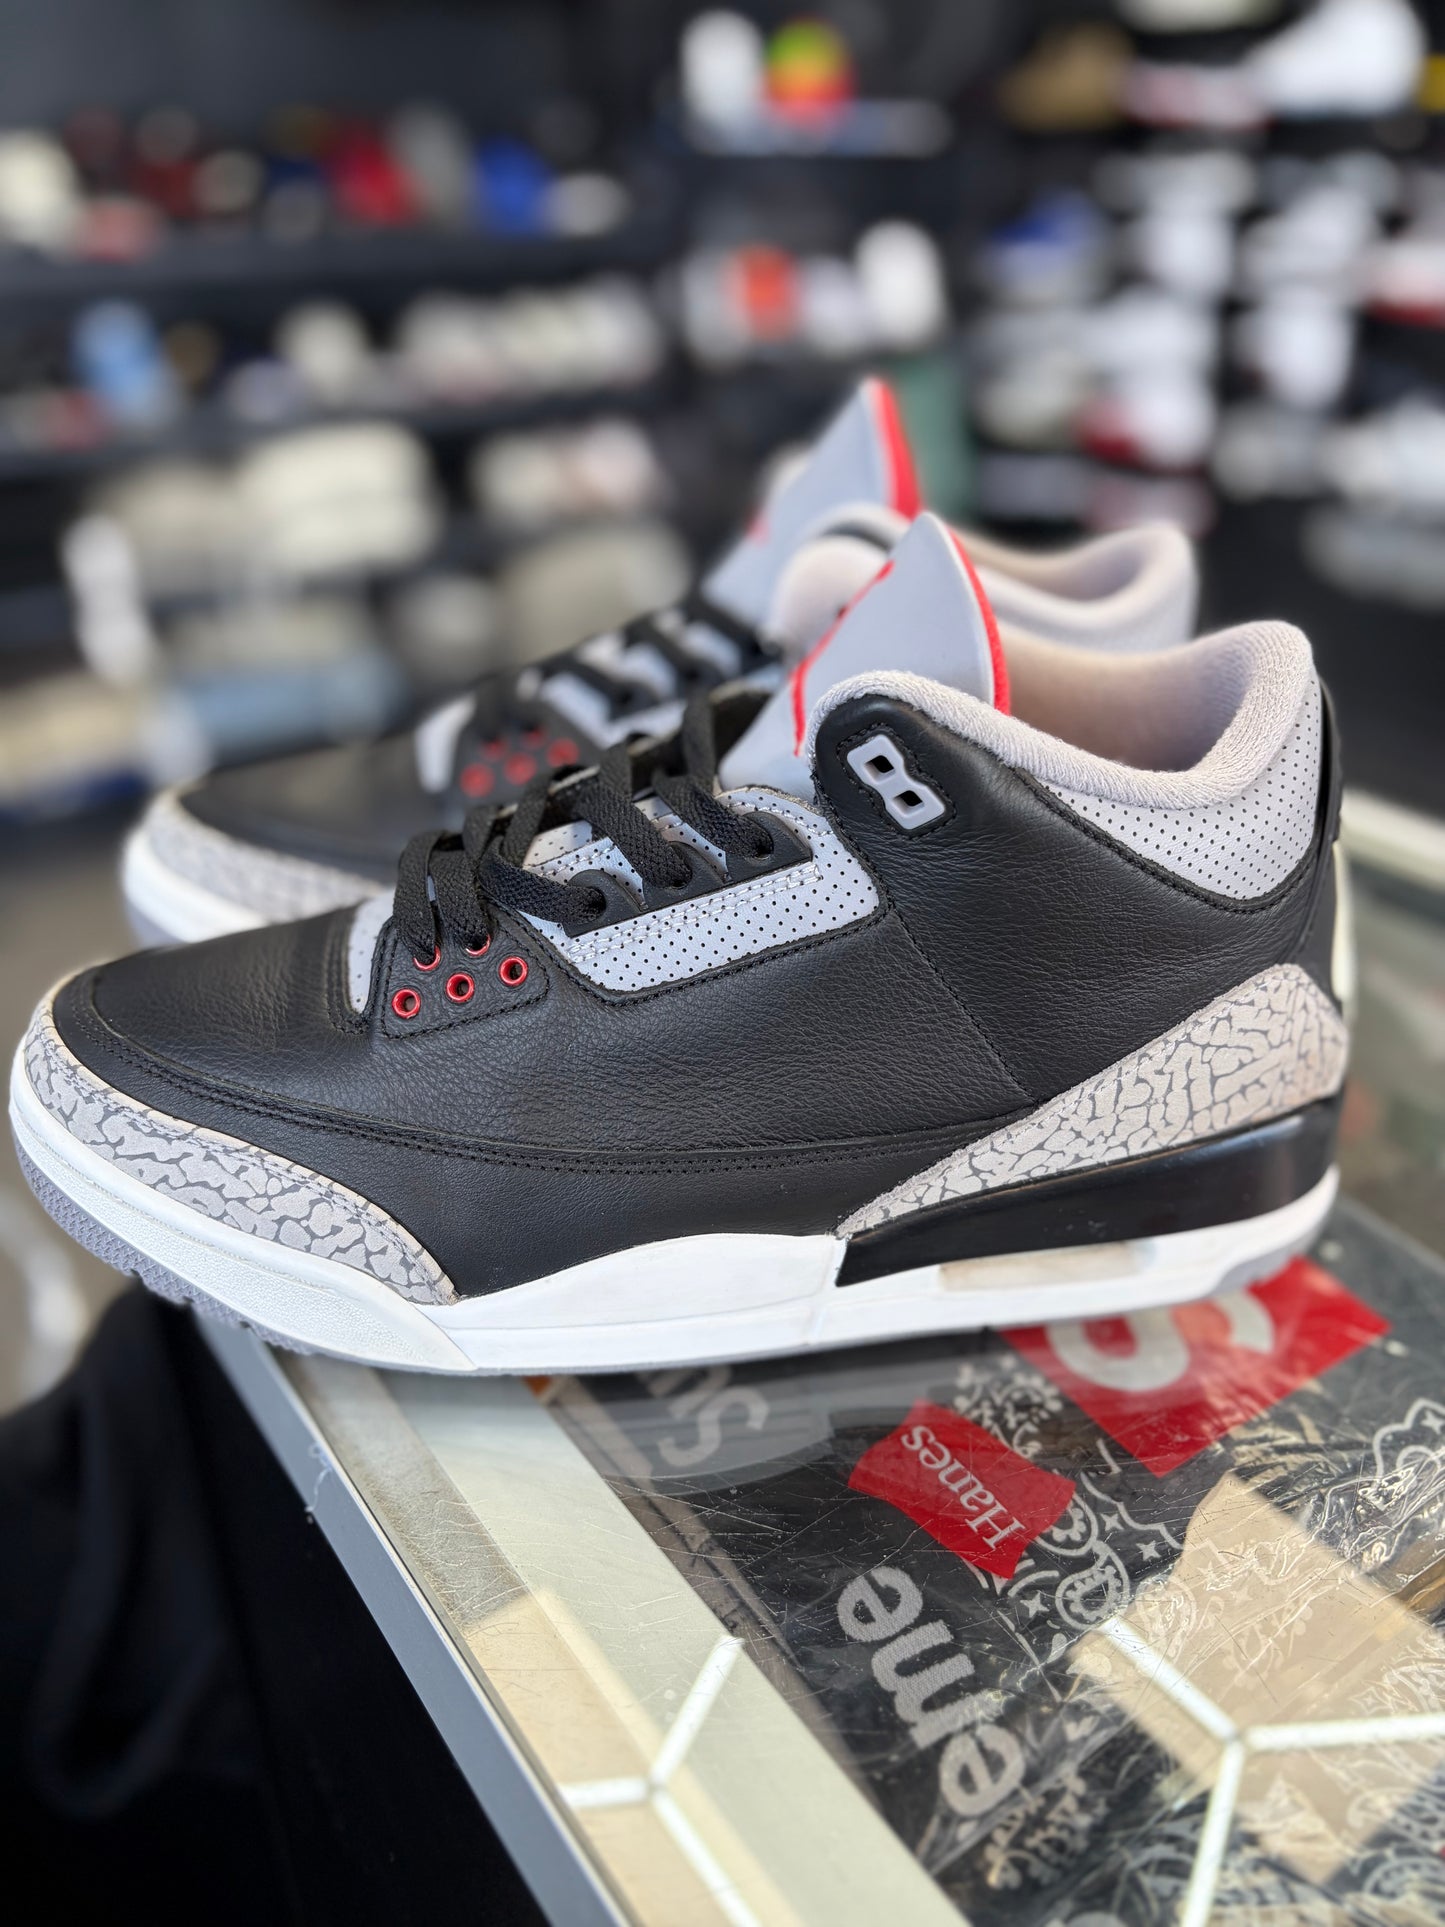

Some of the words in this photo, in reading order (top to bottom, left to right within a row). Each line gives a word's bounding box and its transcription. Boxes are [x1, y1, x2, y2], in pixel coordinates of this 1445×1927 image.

[636, 1366, 769, 1467] Su
[901, 1425, 1026, 1551] Hanes
[837, 1565, 1026, 1835] eme
